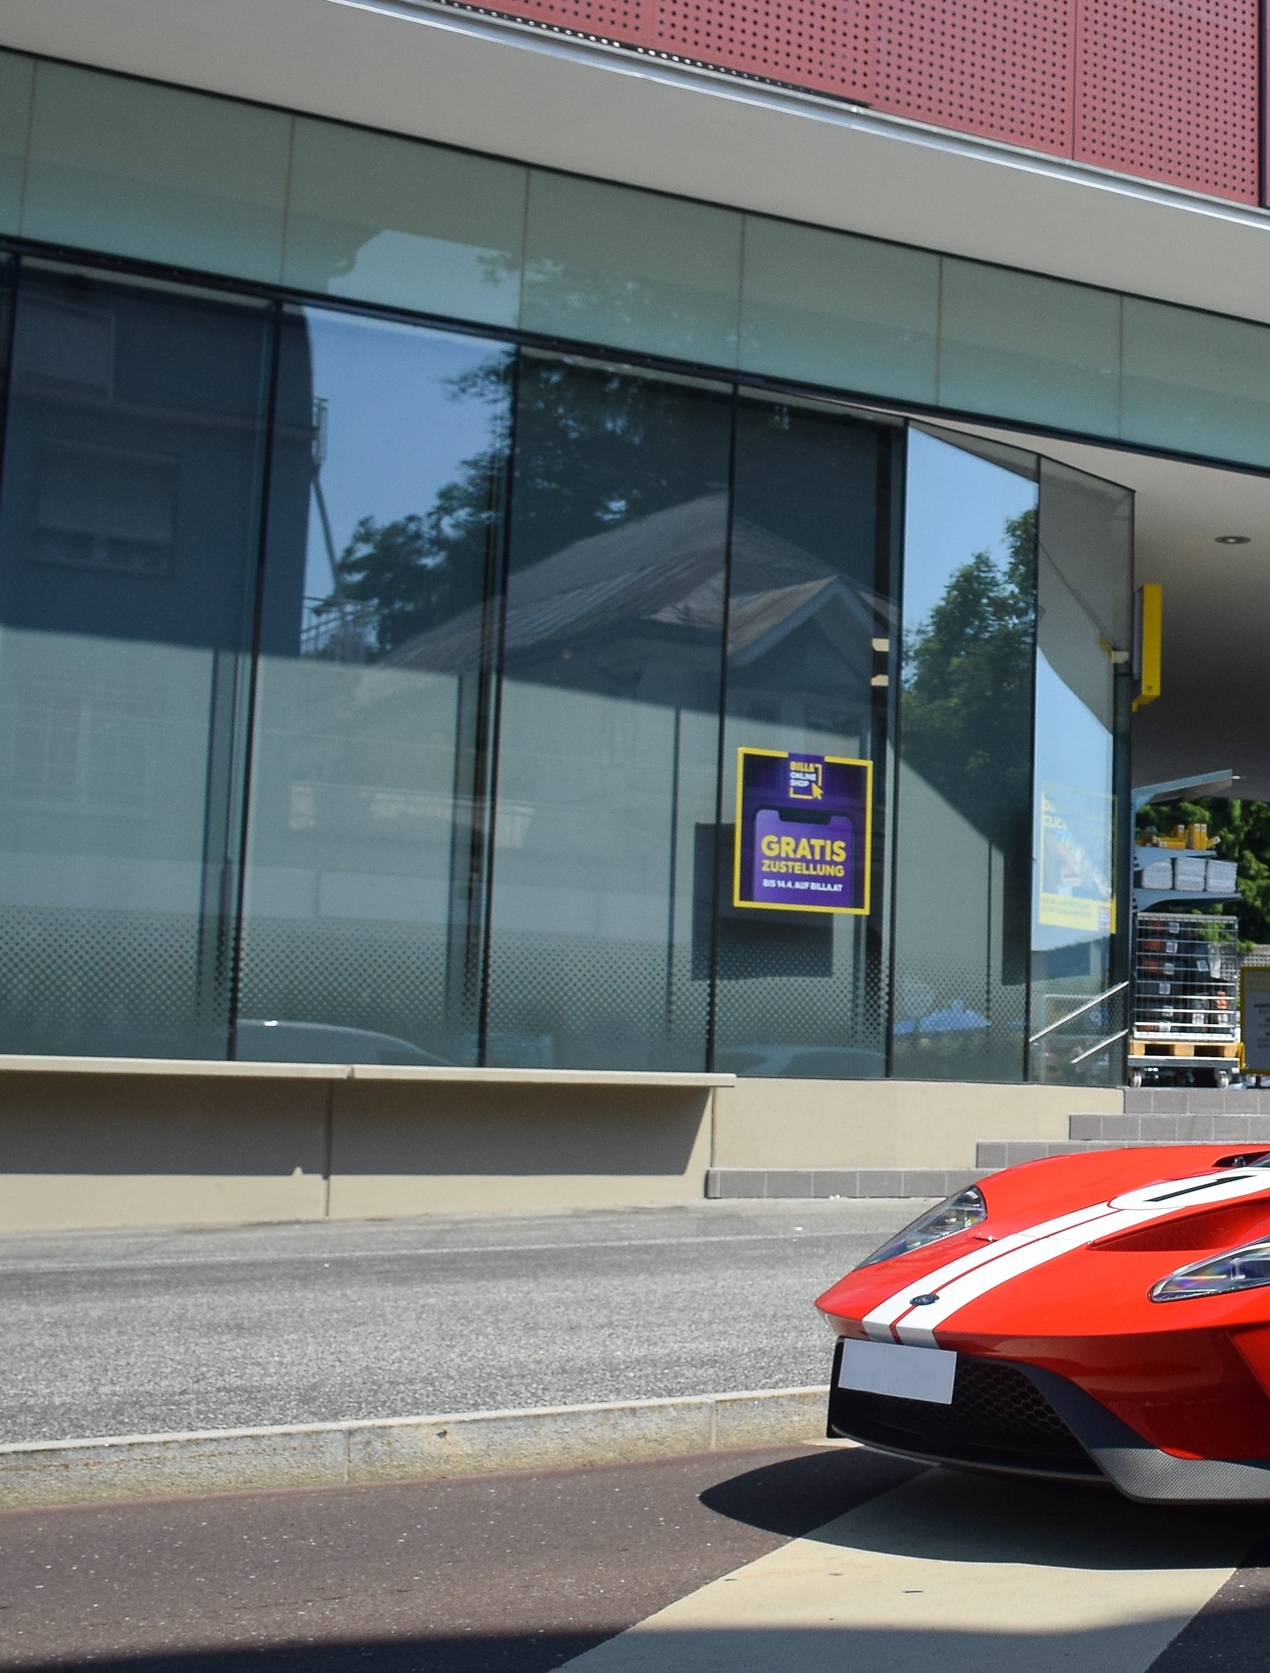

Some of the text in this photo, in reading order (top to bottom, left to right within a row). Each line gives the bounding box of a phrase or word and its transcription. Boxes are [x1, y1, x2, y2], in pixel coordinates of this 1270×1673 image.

[790, 771, 817, 781] ONLINE
[790, 779, 810, 788] SHOP
[761, 834, 846, 862] GRATIS
[761, 859, 845, 877] ZUSTELLUNG
[762, 879, 776, 888] BIS
[1143, 1174, 1259, 1203] 1
